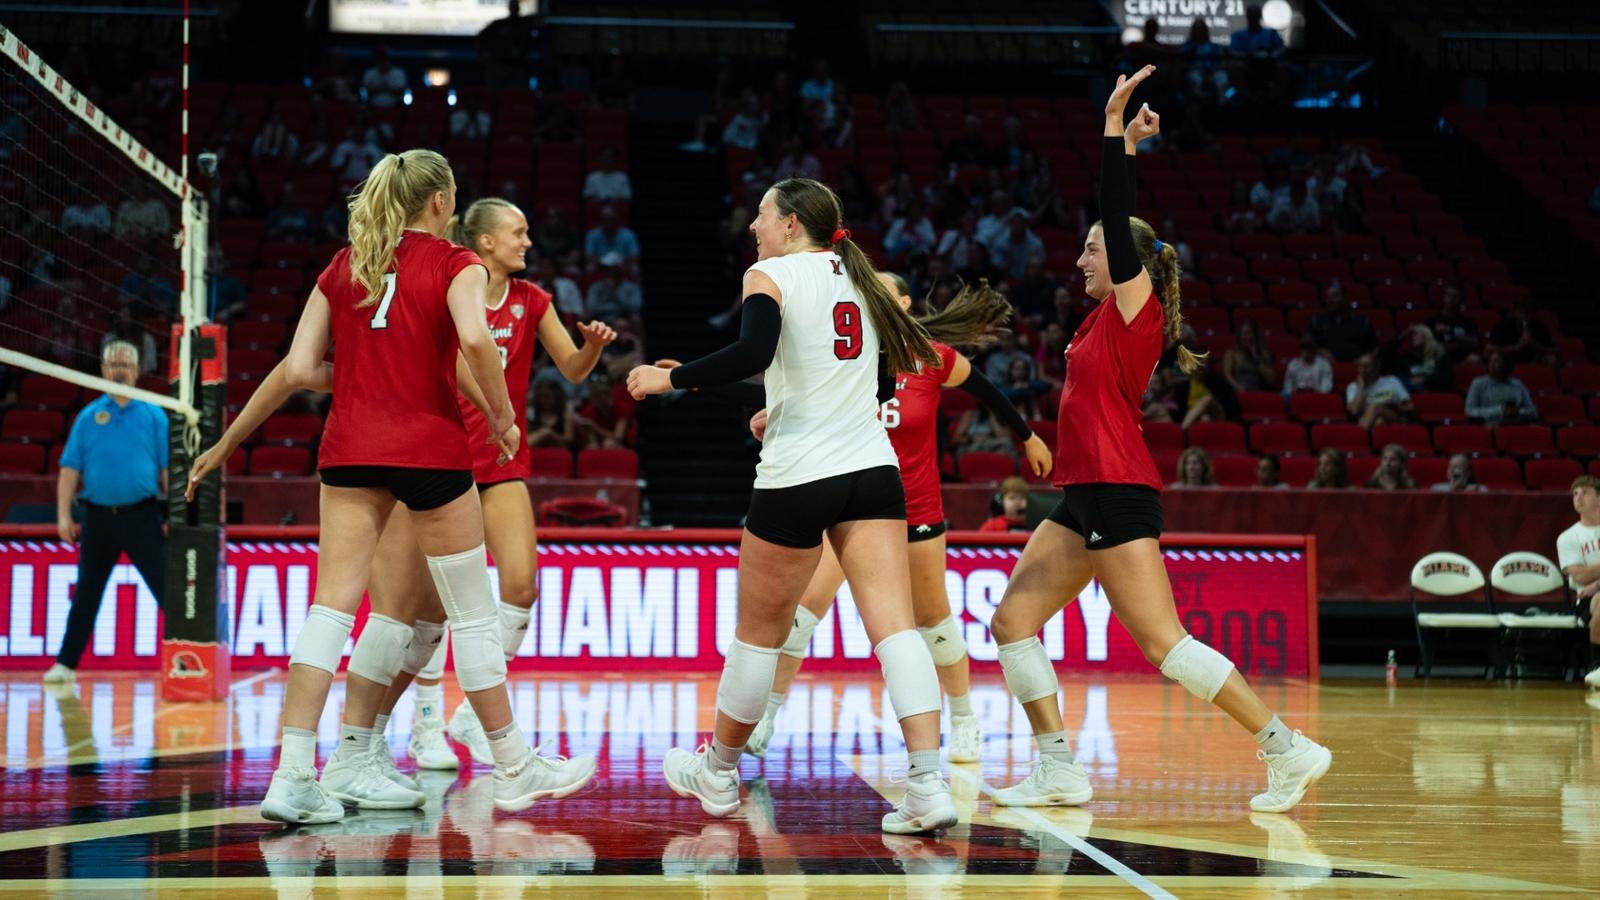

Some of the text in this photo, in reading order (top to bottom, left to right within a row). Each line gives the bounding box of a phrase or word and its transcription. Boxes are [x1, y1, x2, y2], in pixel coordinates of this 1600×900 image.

[1124, 0, 1245, 15] CENTURY 21
[370, 271, 397, 330] 7
[833, 301, 863, 360] 9
[881, 397, 901, 429] 6
[1422, 561, 1470, 577] MIAMI
[1501, 561, 1550, 577] MIAMI
[486, 566, 699, 657] IAMI
